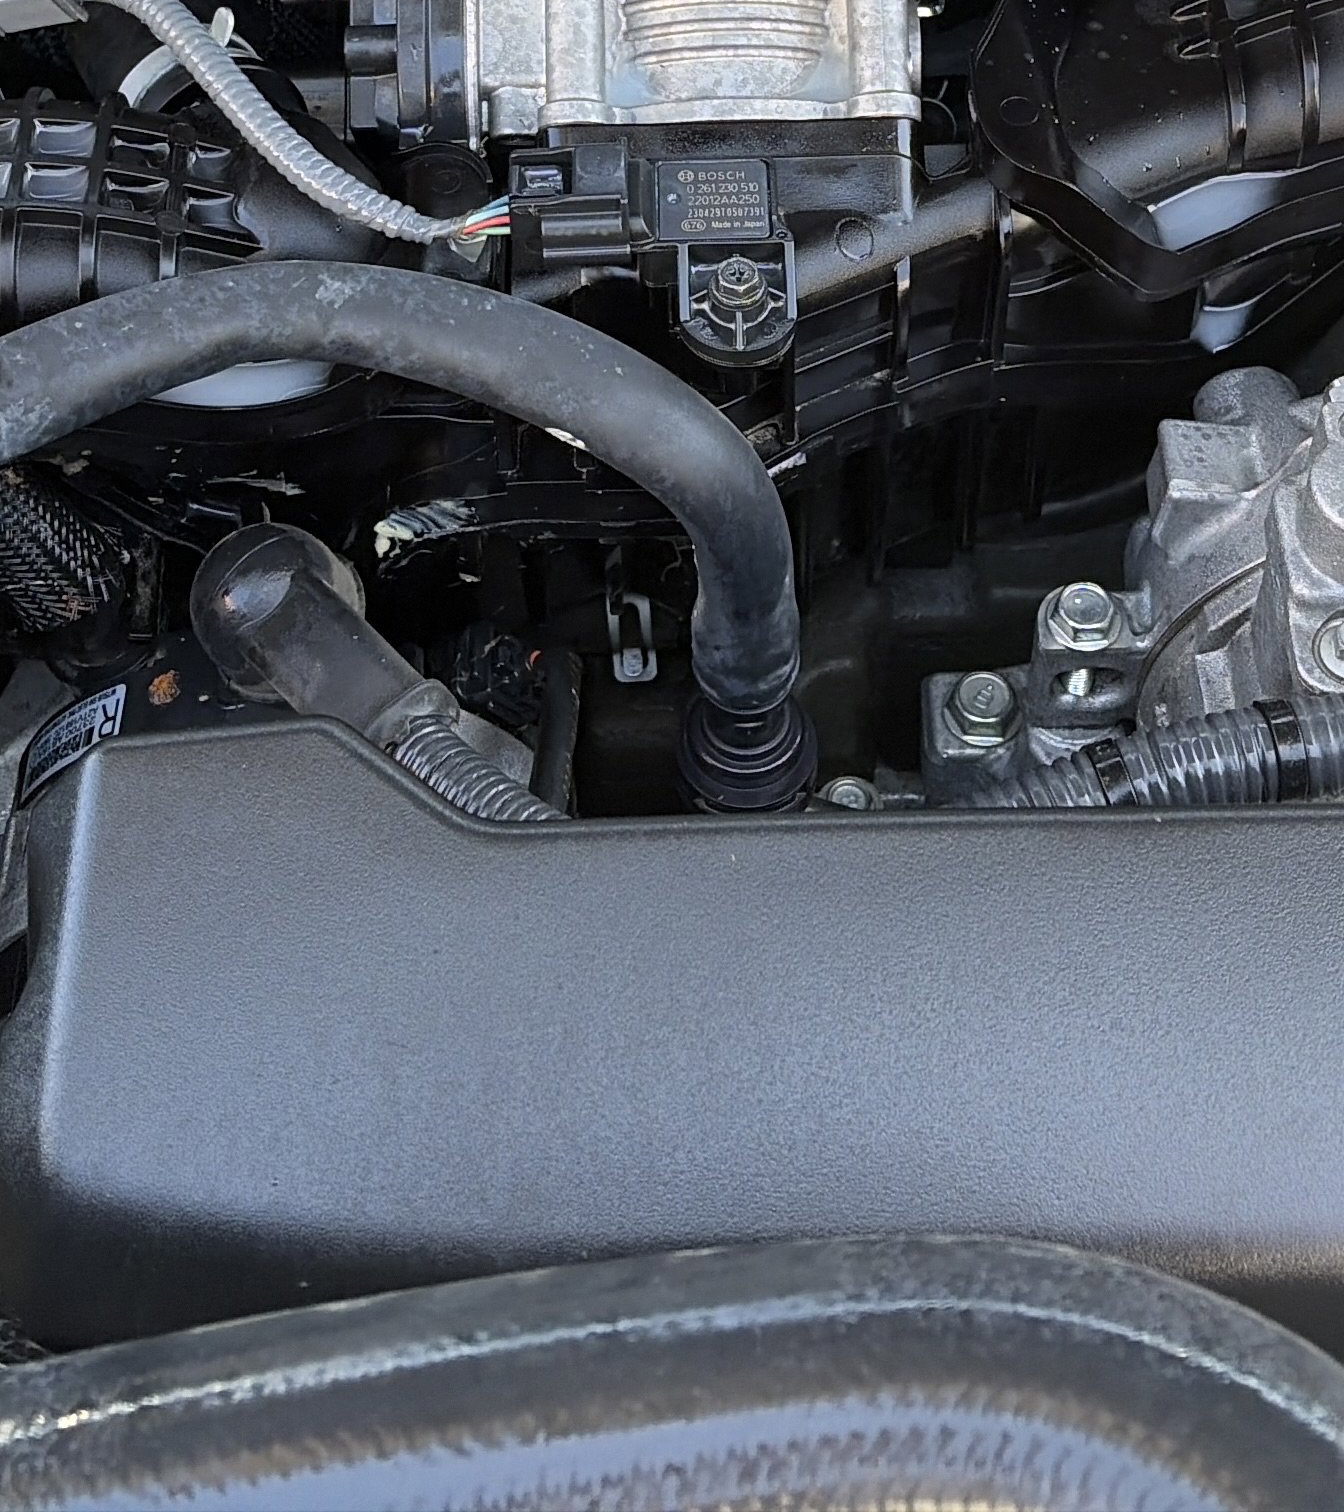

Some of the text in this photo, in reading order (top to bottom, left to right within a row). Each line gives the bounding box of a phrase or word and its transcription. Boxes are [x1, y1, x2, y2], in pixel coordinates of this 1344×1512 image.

[698, 171, 745, 181] BOSCH
[687, 182, 759, 194] 0 261 230 510
[688, 194, 760, 206] 22012AA250
[743, 221, 765, 229] Japan
[98, 699, 121, 738] R
